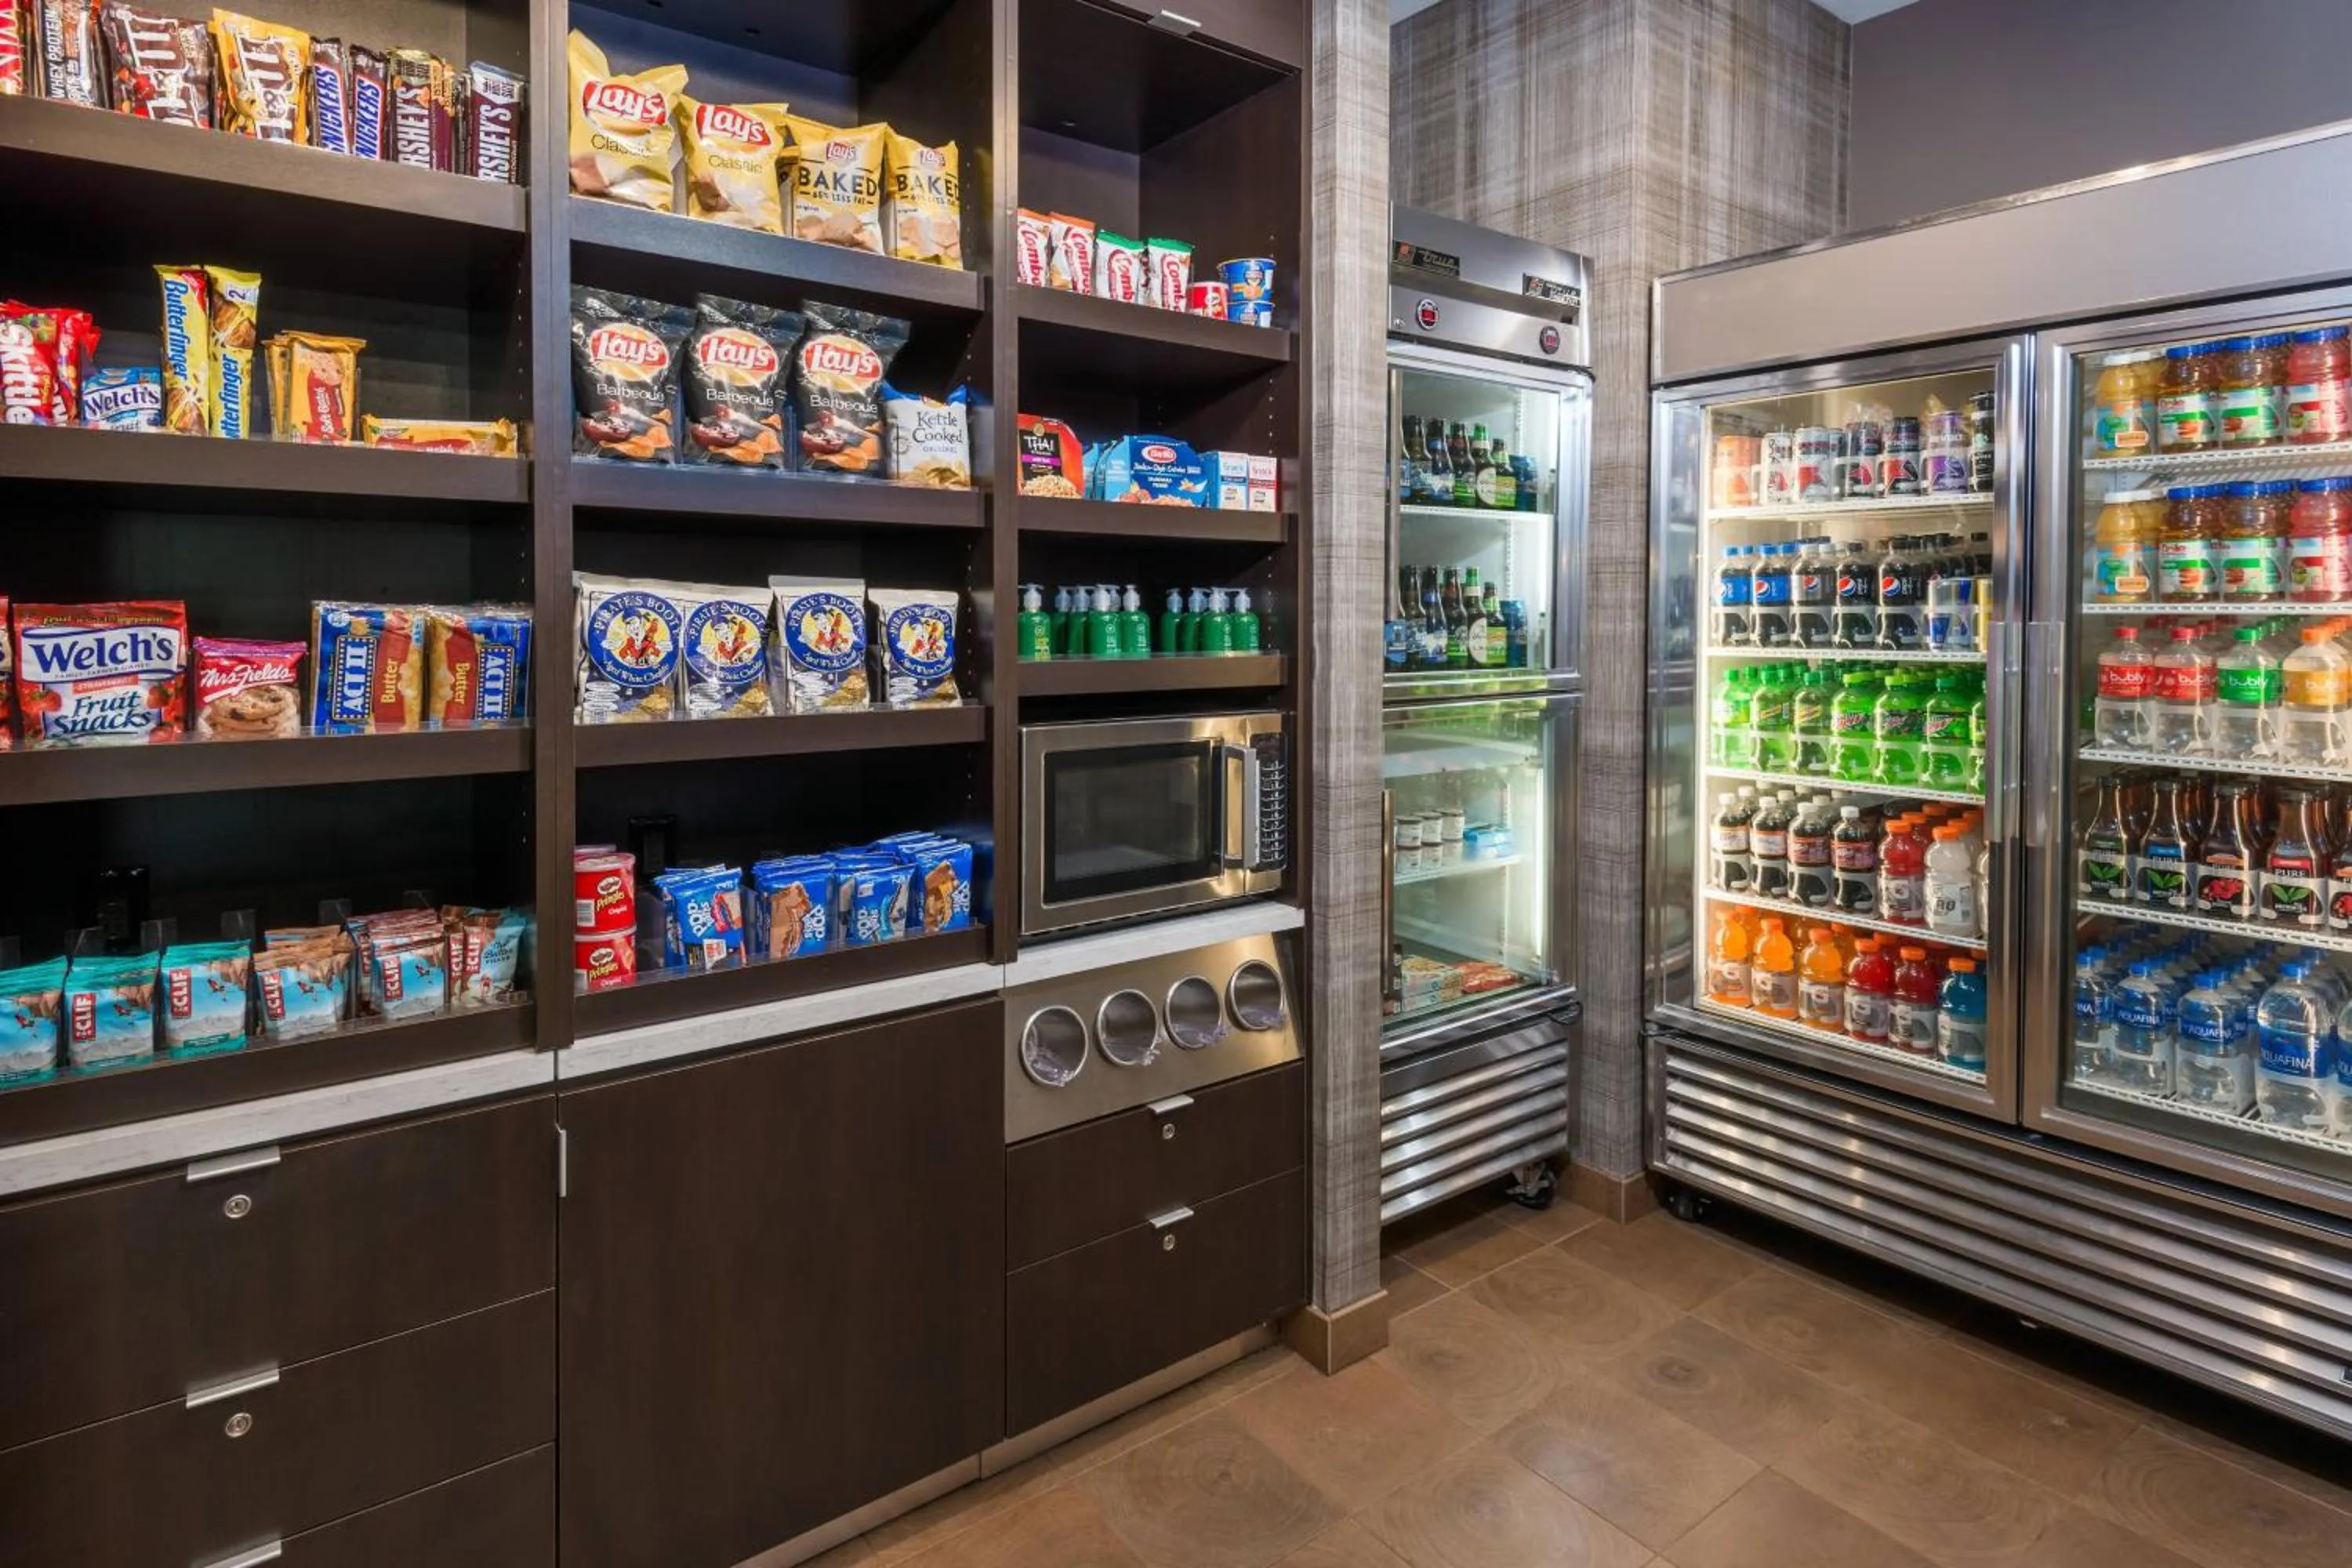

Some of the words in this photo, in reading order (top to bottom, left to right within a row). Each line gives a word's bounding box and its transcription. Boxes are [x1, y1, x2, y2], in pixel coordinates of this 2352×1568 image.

[587, 81, 665, 123] Lay's
[700, 105, 766, 143] Lay's
[798, 166, 877, 196] BAKED
[164, 279, 191, 380] Butterfinger
[597, 332, 662, 365] Lay's
[706, 337, 771, 370] Lay's
[811, 343, 876, 376] Lay's
[82, 385, 159, 416] Welch's
[912, 427, 963, 444] Cooked
[916, 411, 958, 428] Kettle
[1023, 435, 1054, 451] THAI
[28, 632, 174, 673] Welch's
[380, 659, 398, 703] Butter
[453, 662, 470, 705] Butter
[74, 691, 142, 720] Fruit
[52, 709, 152, 738] Snacks
[596, 891, 625, 912] Pringles
[384, 956, 401, 994] CLIF
[589, 962, 619, 981] Pringles
[172, 971, 189, 1011] CLIF
[264, 973, 281, 1010] CLIF
[77, 996, 94, 1029] CLIF
